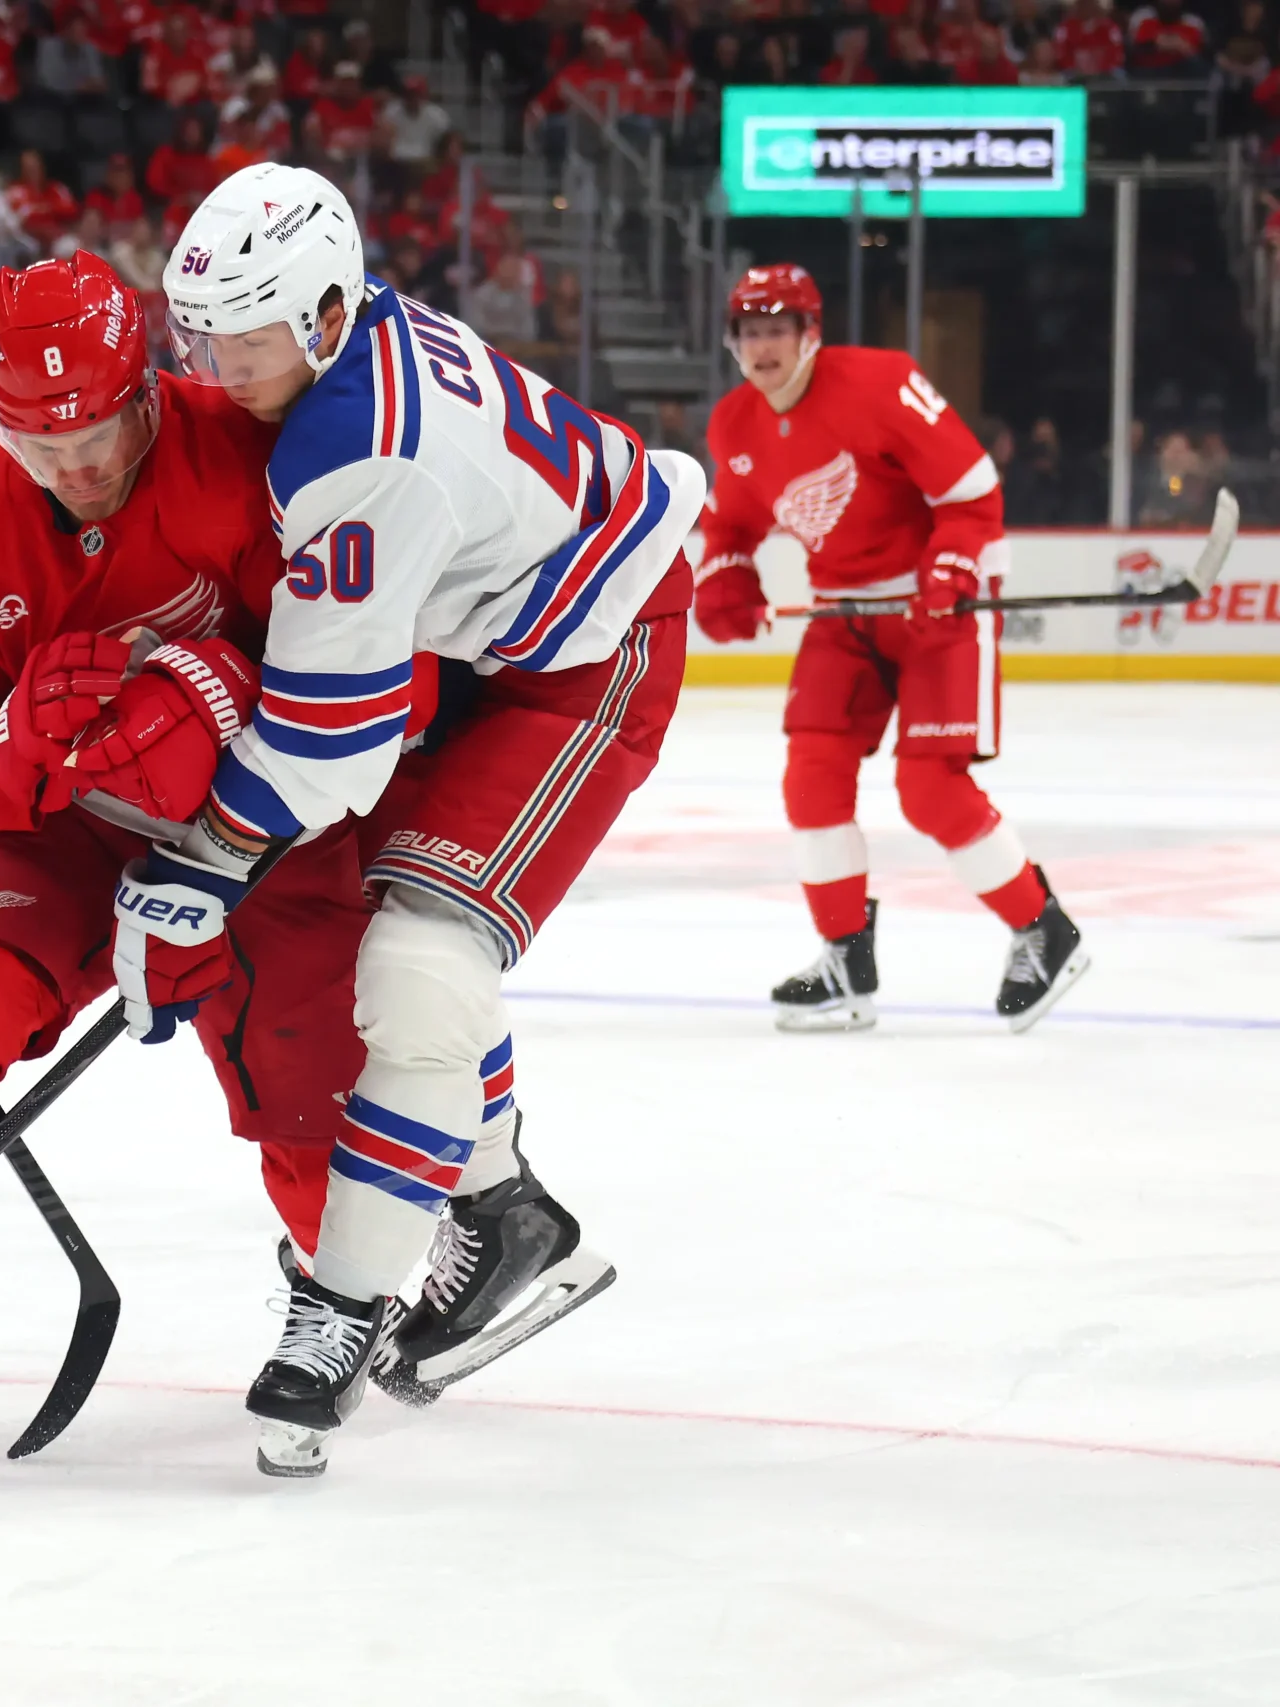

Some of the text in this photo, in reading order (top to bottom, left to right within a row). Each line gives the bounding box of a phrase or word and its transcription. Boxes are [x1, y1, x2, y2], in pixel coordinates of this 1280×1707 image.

[767, 131, 1054, 177] enterprise
[263, 203, 305, 241] Benjamin
[181, 246, 214, 277] 50
[102, 285, 127, 351] meijer
[43, 346, 64, 377] 8
[285, 521, 375, 604] 50
